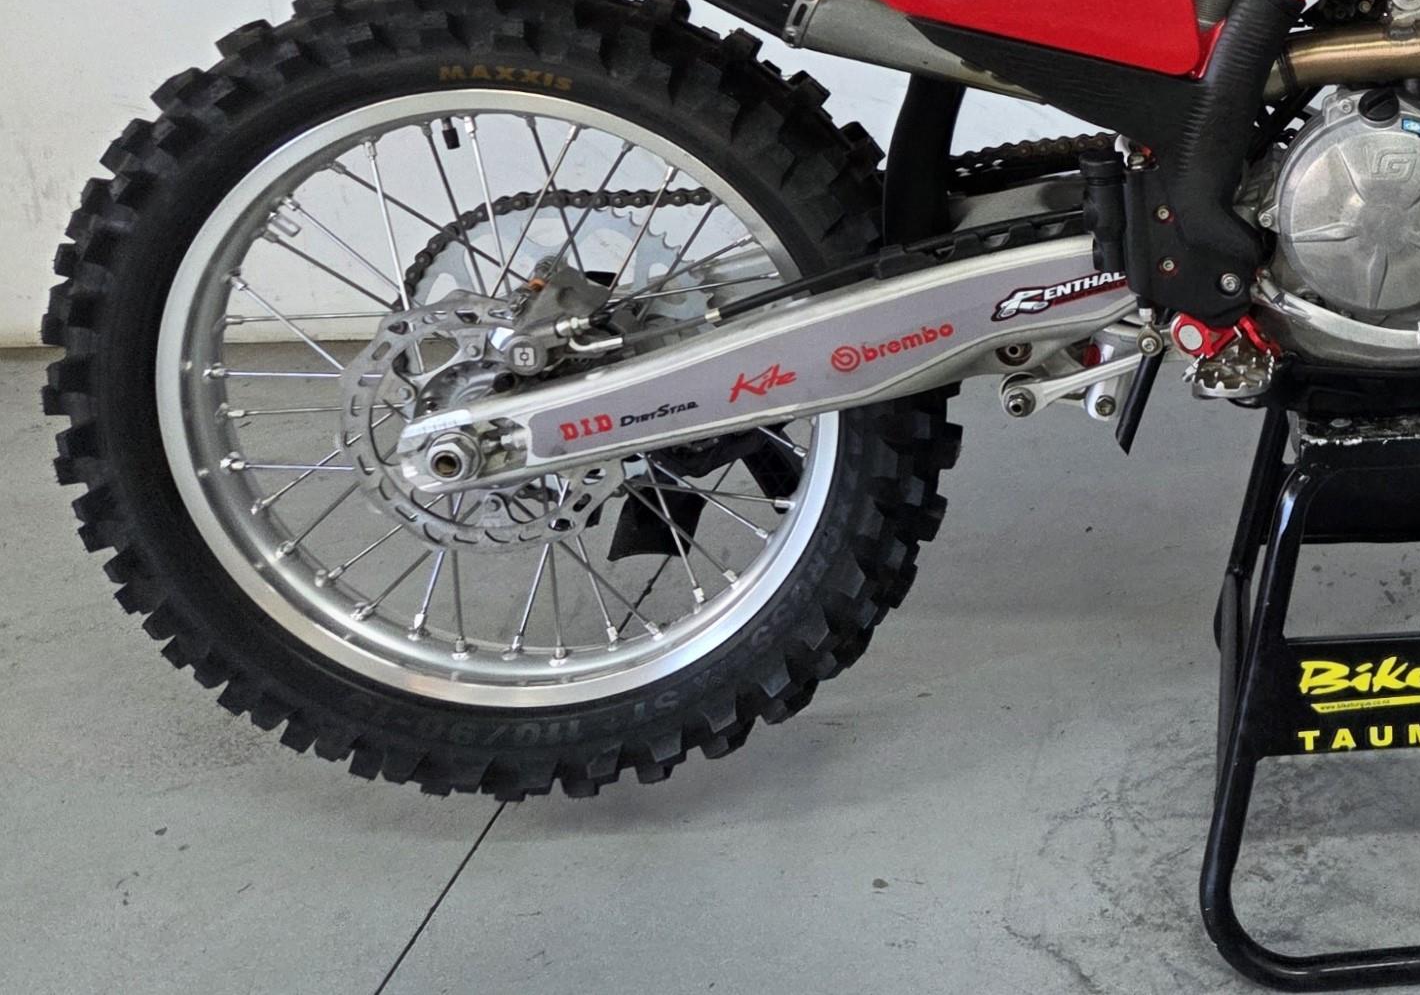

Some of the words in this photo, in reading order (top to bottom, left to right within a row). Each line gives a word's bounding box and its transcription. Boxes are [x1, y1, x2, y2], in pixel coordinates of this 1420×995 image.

[438, 64, 574, 92] MAXXIS
[861, 322, 955, 364] brembo
[729, 363, 798, 404] Kite
